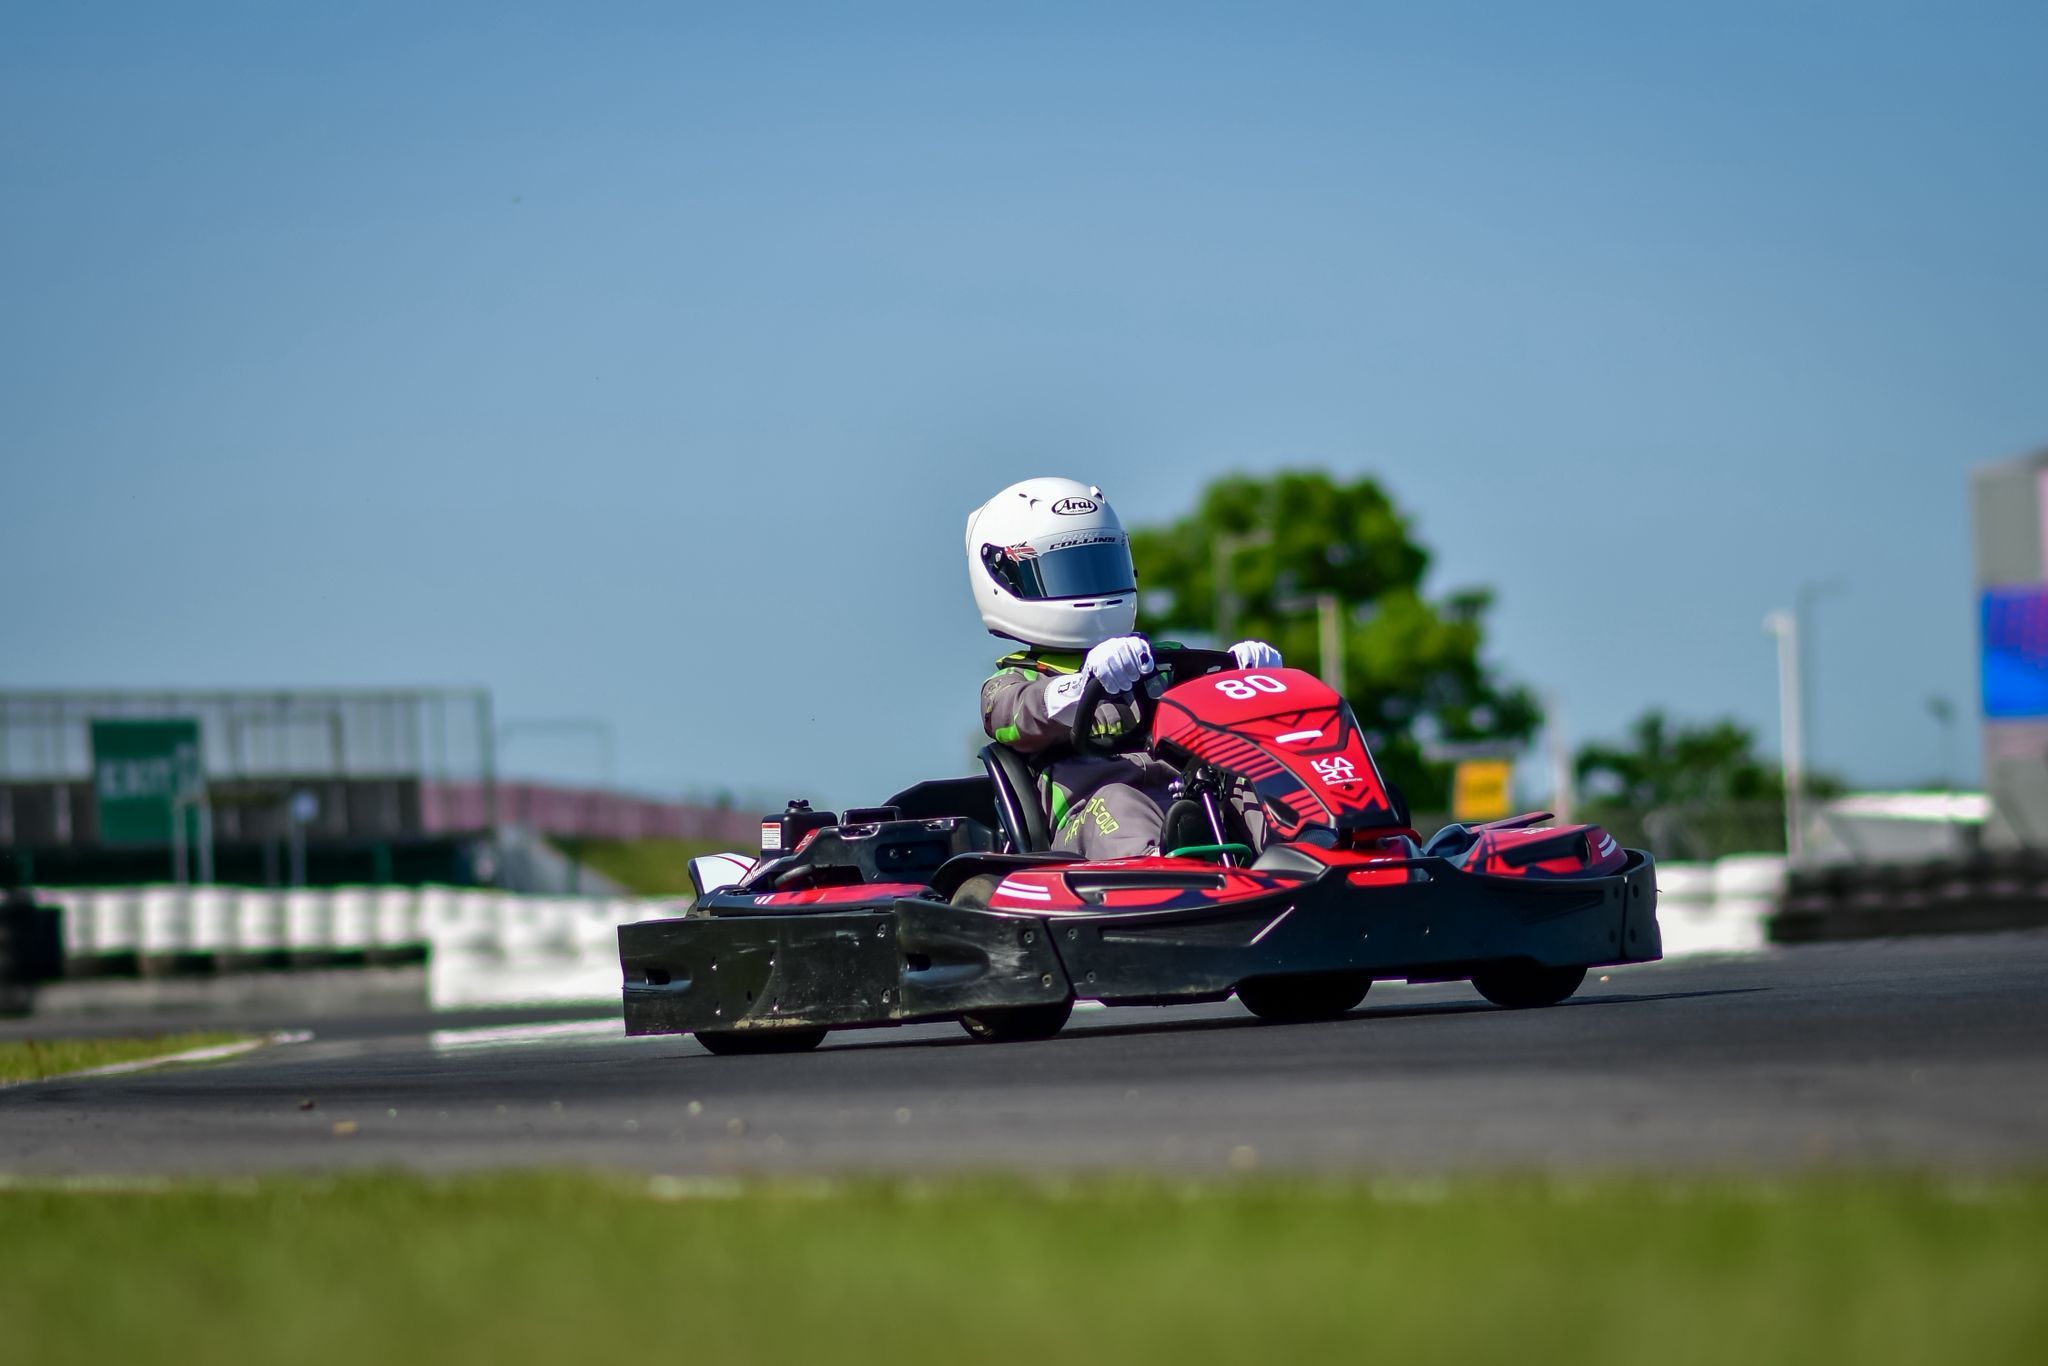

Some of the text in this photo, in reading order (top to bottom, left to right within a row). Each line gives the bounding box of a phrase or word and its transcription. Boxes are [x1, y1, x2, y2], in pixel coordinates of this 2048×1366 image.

[1057, 499, 1094, 513] Arai
[1049, 536, 1116, 550] COLLINS
[1215, 675, 1287, 700] 80
